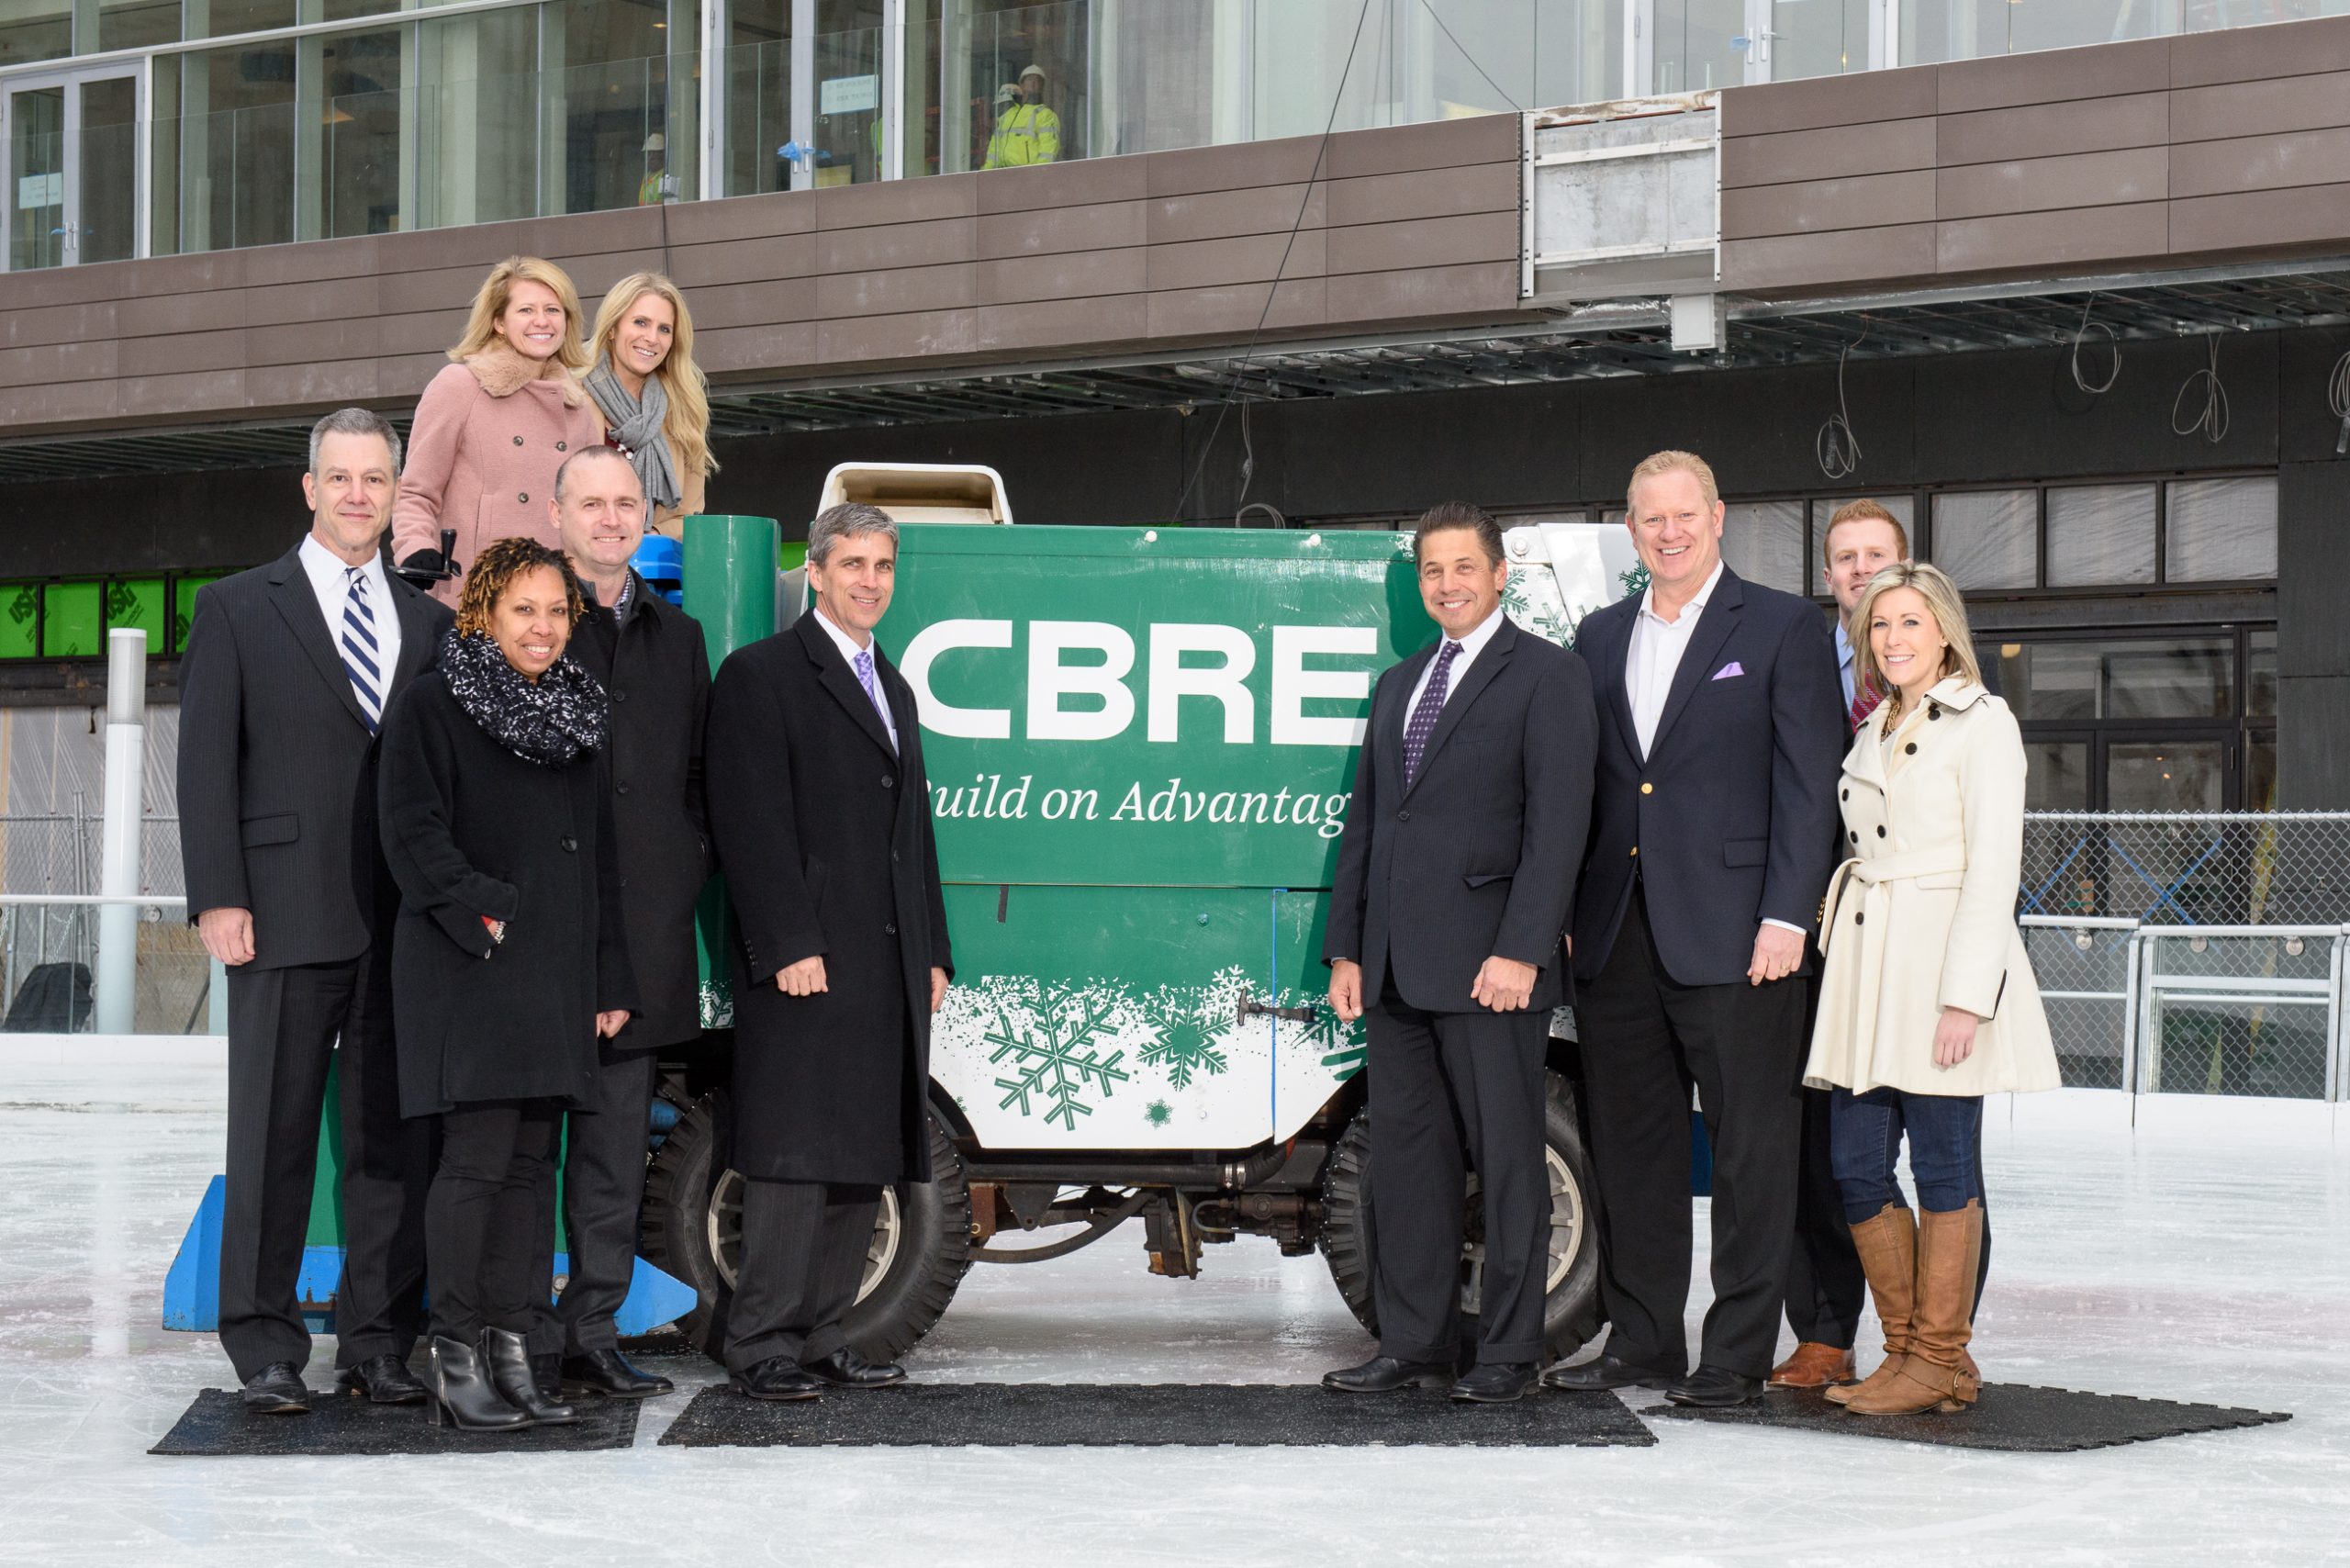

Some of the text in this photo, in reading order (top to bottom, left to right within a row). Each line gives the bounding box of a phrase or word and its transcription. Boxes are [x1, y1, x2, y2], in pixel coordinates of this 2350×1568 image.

[899, 619, 1377, 745] CBRE
[926, 773, 1352, 838] uild on Advantag
